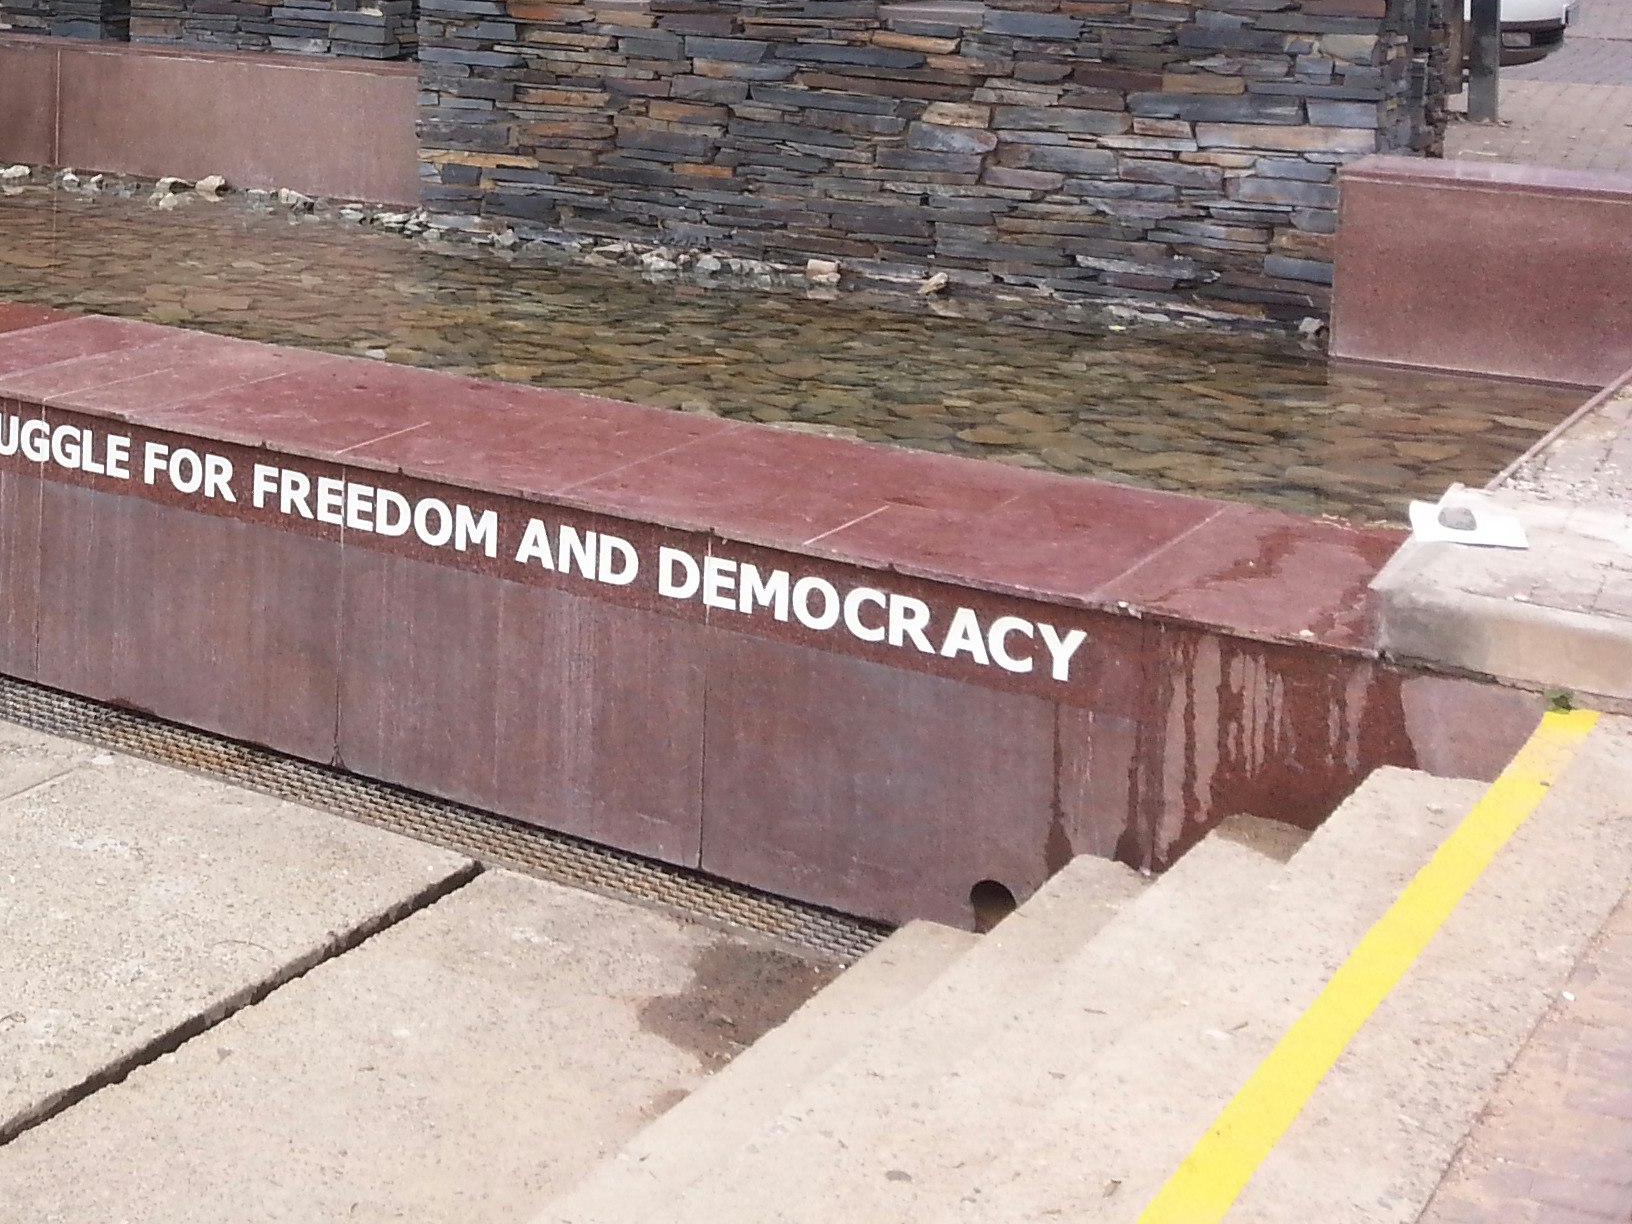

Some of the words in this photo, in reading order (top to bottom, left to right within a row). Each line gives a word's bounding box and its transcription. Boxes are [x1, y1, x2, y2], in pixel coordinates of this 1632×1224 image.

[144, 442, 237, 503] FOR
[253, 463, 498, 558] FREEDOM
[515, 518, 639, 585] AND
[658, 546, 1087, 682] DEMOCRACY
